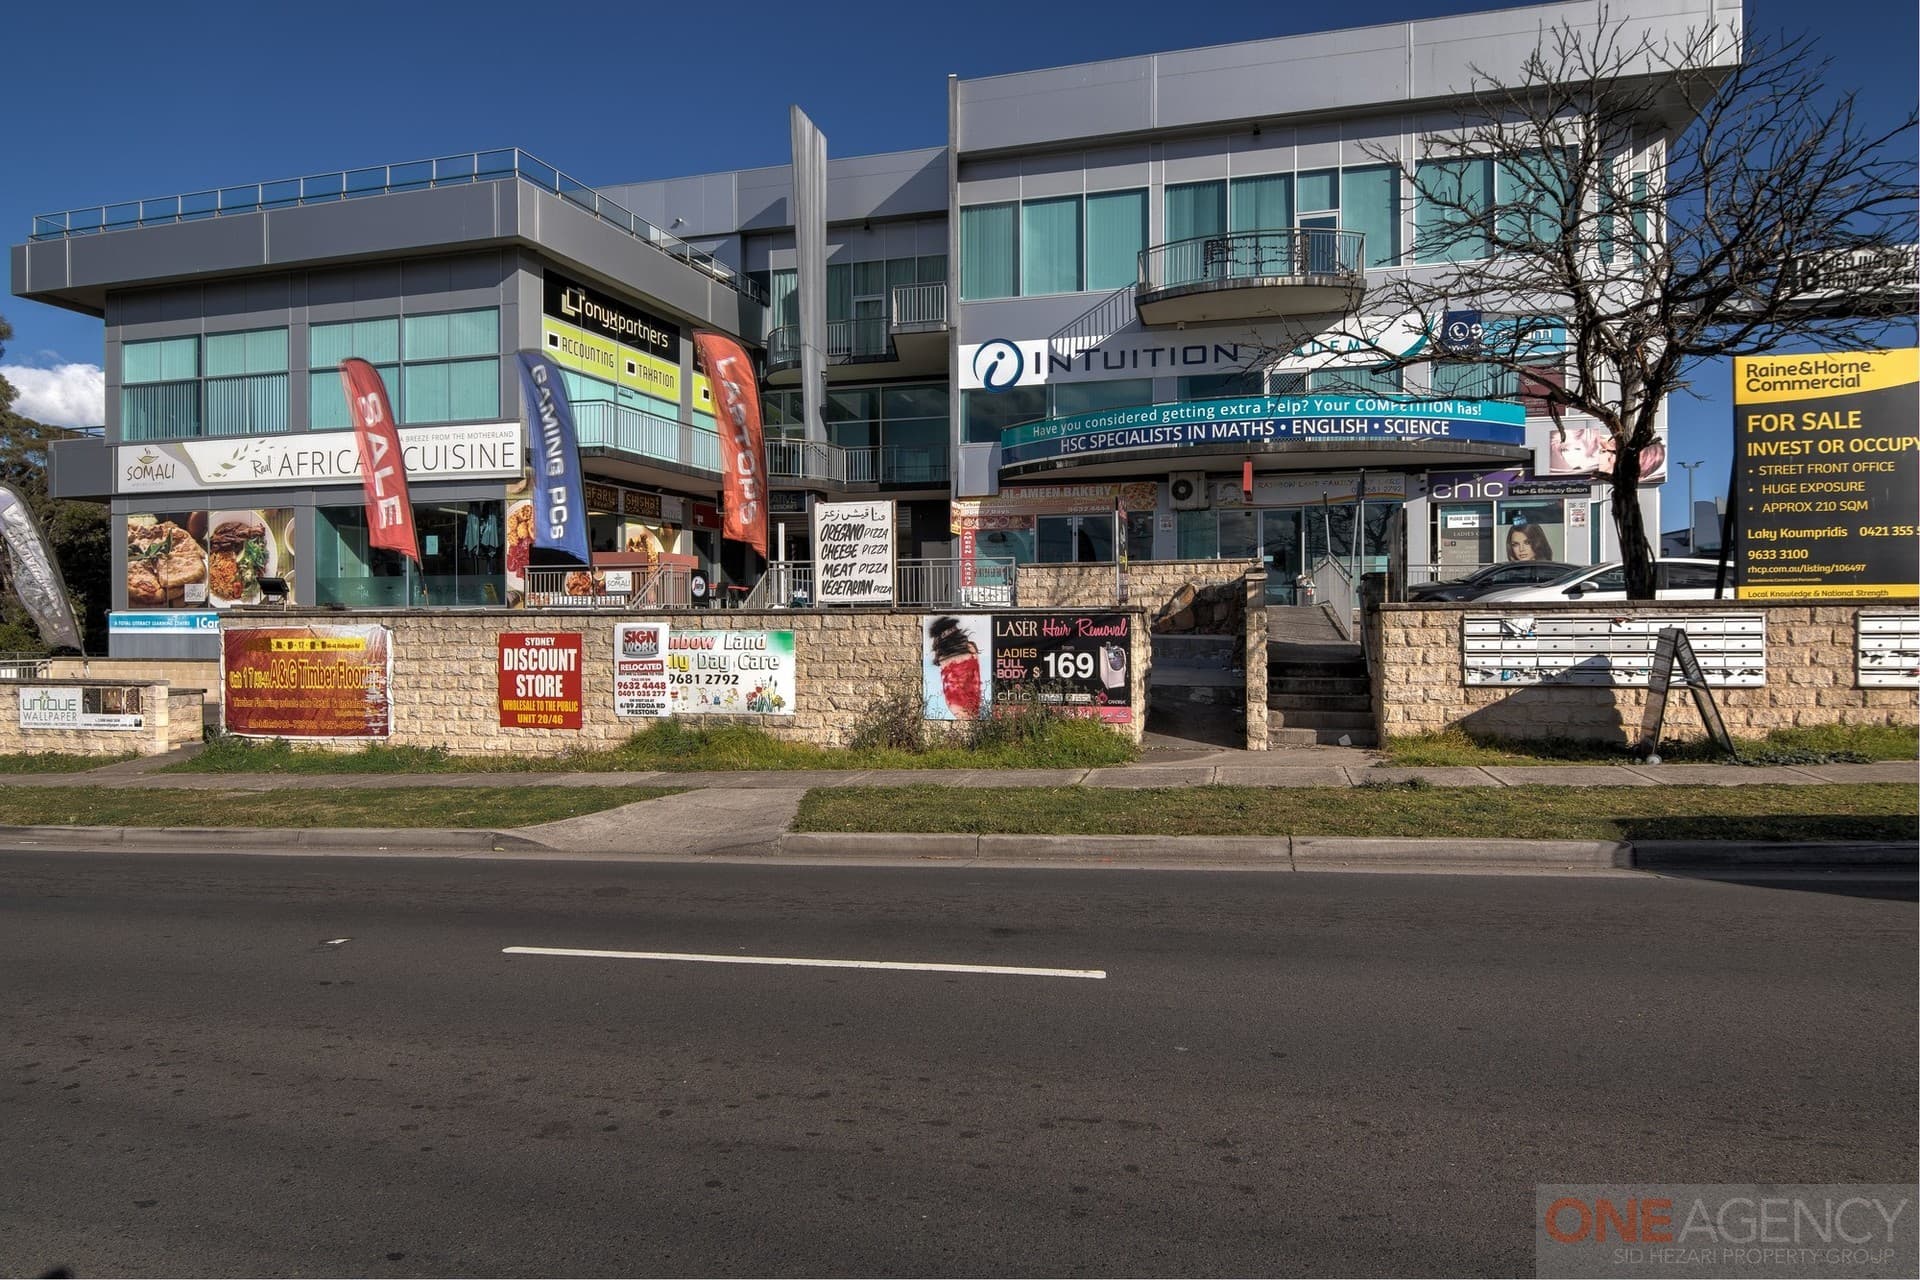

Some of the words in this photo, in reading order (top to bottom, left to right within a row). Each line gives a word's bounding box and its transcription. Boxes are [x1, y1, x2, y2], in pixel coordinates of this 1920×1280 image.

[585, 302, 669, 348] onyxpartners
[562, 337, 614, 368] ACCOUNTING
[1034, 343, 1239, 374] INTUITION
[638, 364, 674, 388] TAXATION
[1746, 361, 1871, 378] Raine&Horne
[1746, 374, 1861, 392] Commercial
[1033, 425, 1057, 437] Have
[1060, 422, 1081, 436] you
[1085, 410, 1157, 429] considered
[1162, 404, 1215, 423] getting
[1220, 403, 1261, 416] extra
[1267, 400, 1309, 415] help?
[1313, 400, 1350, 412] Your
[1355, 399, 1453, 414] COMPETITION
[1457, 404, 1482, 416] has!
[1748, 413, 1796, 433] FOR
[1802, 410, 1862, 431] SALE
[405, 433, 429, 442] BREEZE
[432, 432, 450, 442] FROM
[452, 432, 465, 440] THE
[467, 431, 514, 440] MOTHERLAND
[715, 356, 758, 525] LAPTOPS
[1061, 436, 1087, 453] HSC
[1089, 426, 1182, 449] SPECIALISTS
[1187, 424, 1206, 440] IN
[1212, 420, 1275, 437] MATHS
[1292, 419, 1368, 434] ENGLISH
[1384, 420, 1450, 435] SCIENCE
[531, 364, 565, 476] GAMING
[548, 486, 568, 540] PCs
[1748, 440, 1813, 457] INVEST
[1818, 439, 1845, 454] OR
[251, 456, 272, 478] Real
[278, 449, 371, 476] AFRICA
[402, 442, 516, 472] CUISINE
[357, 392, 403, 529] SALE
[1758, 464, 1804, 476] STREET
[1807, 463, 1849, 474] FRONT
[1853, 461, 1895, 472] OFFICE
[127, 464, 175, 481] SOMALI
[1001, 488, 1060, 499] AL-AMEEN
[1064, 485, 1113, 498] BAKERY
[1432, 478, 1503, 499] chic
[1538, 487, 1565, 496] Beauty
[1566, 486, 1588, 494] Salon
[1762, 483, 1797, 494] HUGE
[1800, 481, 1866, 493] EXPOSURE
[1762, 502, 1812, 513] APPROX
[1816, 502, 1837, 512] 210
[1840, 500, 1869, 512] SQM
[820, 523, 865, 542] OREGANO
[864, 528, 888, 539] PIZZA
[1780, 526, 1848, 540] Koumpridis
[1859, 525, 1889, 537] 0421
[1891, 525, 1914, 537] 355
[821, 544, 859, 560] CHEESE
[862, 544, 888, 555] PIZZA
[1747, 549, 1776, 560] 9633
[1779, 549, 1809, 560] 3100
[822, 563, 857, 578] MEAT
[858, 563, 888, 574] PIZZA
[822, 579, 873, 596] VEGETARIAN
[873, 585, 892, 595] PIZZA
[1747, 590, 1768, 598] Local
[1770, 590, 1812, 599] Knowledge
[1822, 590, 1854, 598] National
[1856, 589, 1889, 598] Strength
[996, 620, 1038, 637] LASER
[1042, 617, 1070, 637] Hair
[1075, 618, 1128, 637] Removal
[525, 637, 555, 646] SYDNEY
[624, 631, 657, 643] SIGN
[669, 633, 716, 650] nbow
[724, 633, 766, 650] Land
[624, 643, 657, 652] WORK
[503, 648, 577, 671] DISCOUNT
[620, 663, 662, 671] RELOCATED
[697, 653, 730, 673] Day
[738, 654, 780, 670] Care
[996, 648, 1037, 658] LADIES
[1043, 652, 1094, 678] 169
[996, 659, 1024, 668] FULL
[270, 659, 297, 689] A&G
[298, 659, 337, 689] Timber
[669, 674, 700, 685] 9681
[705, 674, 739, 685] 2792
[996, 669, 1028, 679] BODY
[516, 674, 563, 697] STORE
[642, 682, 666, 690] 4448
[503, 700, 536, 711] WHOLESALE
[537, 700, 545, 711] TO
[546, 700, 556, 711] THE
[557, 701, 578, 712] PUBLIC
[23, 711, 77, 722] WALLPAPER
[517, 714, 536, 723] UNIT
[538, 714, 563, 724] 20/46
